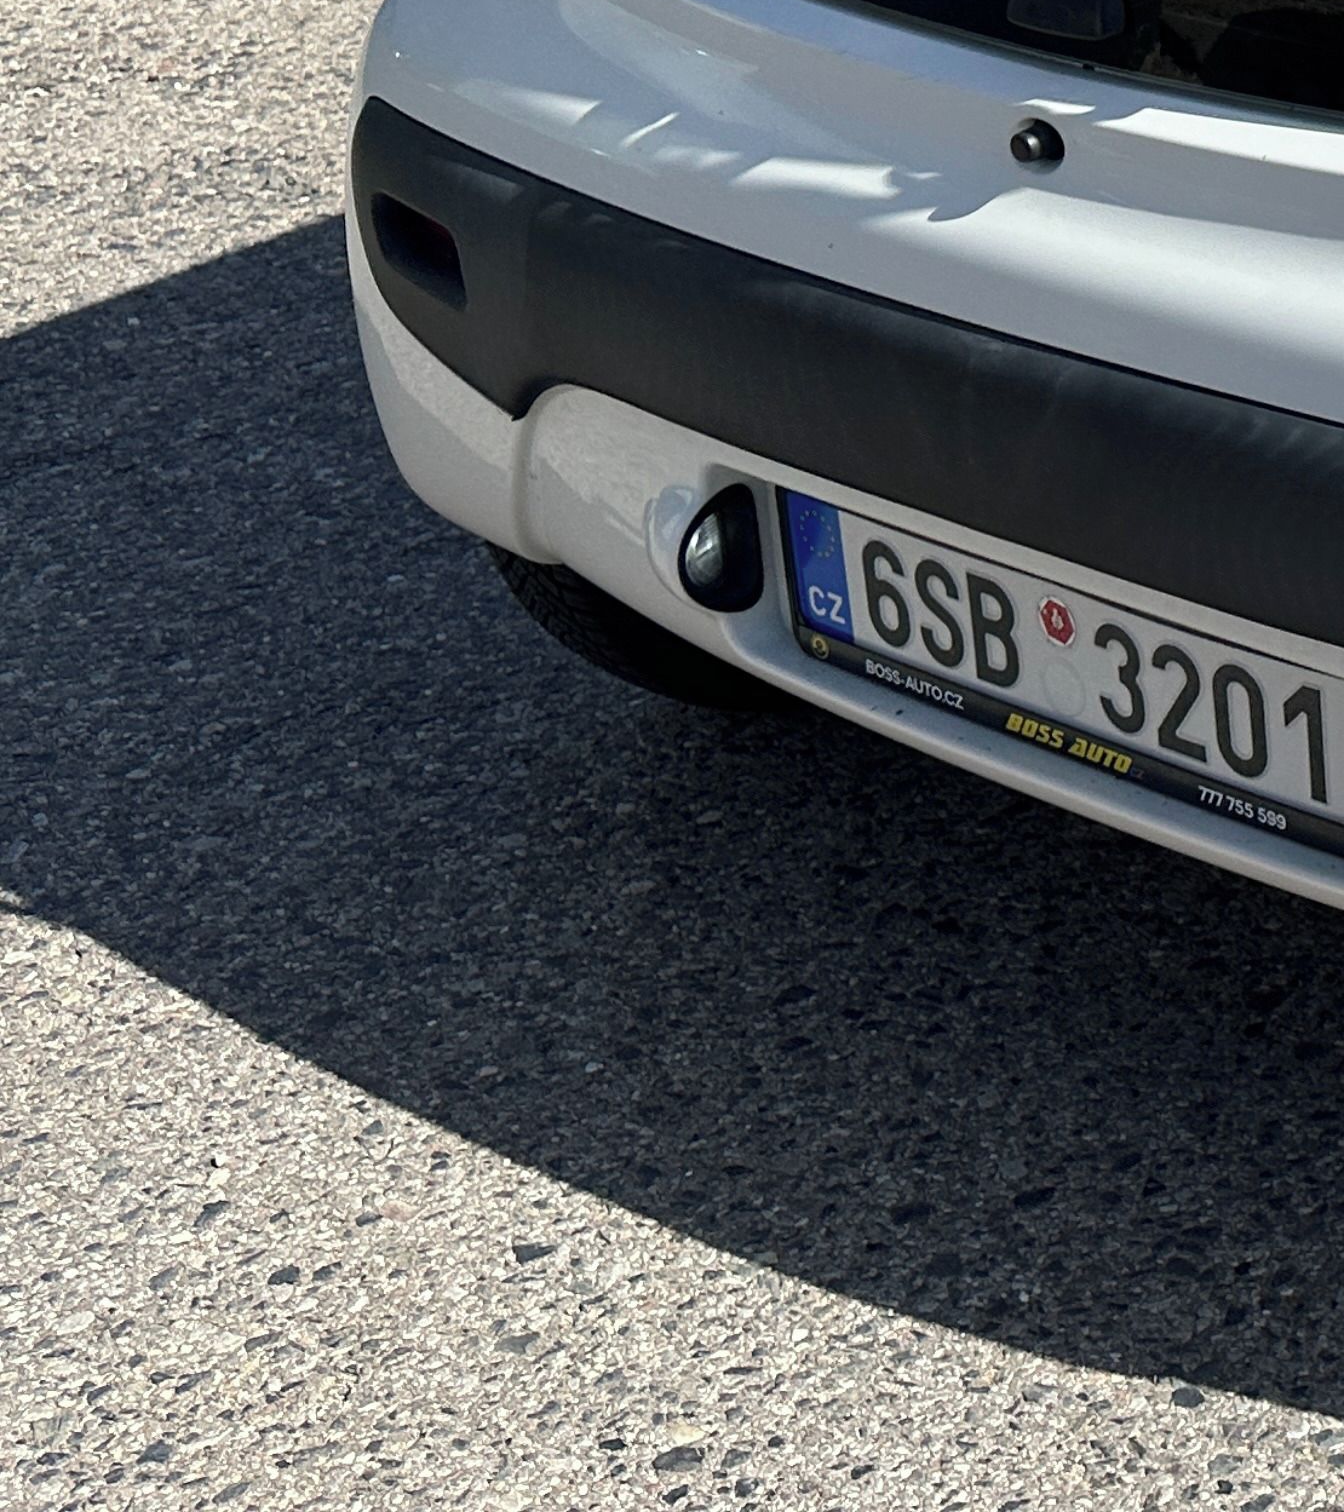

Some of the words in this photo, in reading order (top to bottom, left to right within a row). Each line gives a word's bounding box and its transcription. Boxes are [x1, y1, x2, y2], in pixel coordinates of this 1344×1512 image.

[808, 585, 847, 625] CZ
[861, 539, 1021, 689] 6SB
[1094, 622, 1329, 805] 3201
[865, 658, 966, 711] BOSS-AUTO.CZ
[1005, 712, 1064, 749] BOSS
[1067, 734, 1134, 775] AUTO
[1198, 785, 1224, 808] 777
[1226, 794, 1255, 819] 755
